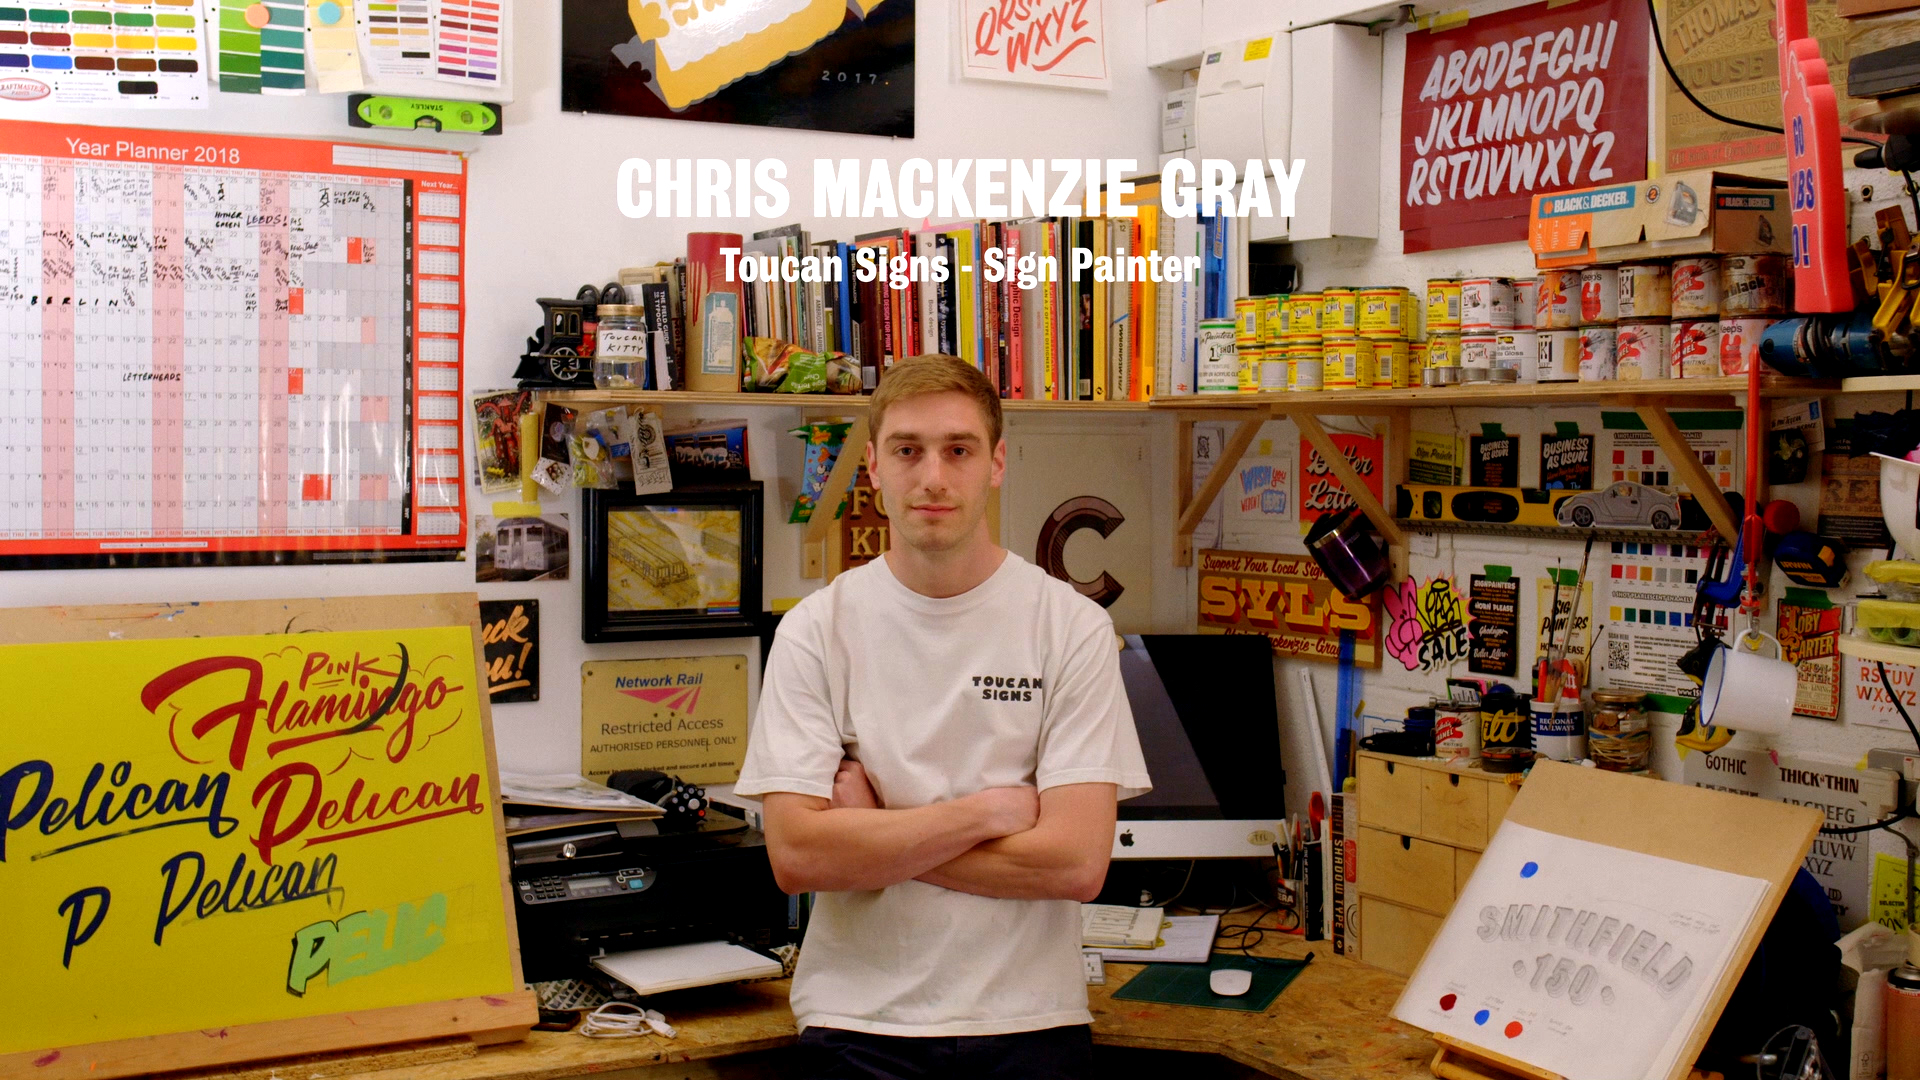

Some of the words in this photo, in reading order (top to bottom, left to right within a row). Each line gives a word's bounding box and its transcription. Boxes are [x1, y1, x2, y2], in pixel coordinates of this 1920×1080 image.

[1673, 0, 1762, 54] THOMAS
[1419, 19, 1617, 102] ABCDEFGHI
[410, 101, 444, 112] STANLEY
[1415, 77, 1604, 156] JKLMNOPQ
[66, 137, 112, 158] Year
[116, 140, 190, 163] Planner
[194, 145, 241, 165] 2018
[1406, 130, 1615, 207] RSTUVWXYZ
[421, 180, 437, 188] Next
[1012, 307, 1021, 337] Design
[1180, 299, 1188, 325] Identity
[927, 317, 935, 337] design
[603, 332, 644, 345] TOUCAN
[606, 344, 644, 353] KITTY
[122, 371, 181, 383] LETTERHEADS
[1543, 438, 1589, 458] BUSINESS
[1546, 456, 1560, 470] AS
[1560, 451, 1588, 467] USUAL
[1036, 495, 1126, 610] C
[1203, 555, 1241, 571] Support
[1244, 557, 1268, 573] Your
[1272, 559, 1299, 575] Local
[1780, 560, 1813, 570] IRWIN
[1492, 603, 1515, 613] PLEASE
[1419, 627, 1468, 671] SALE
[616, 674, 673, 689] Network
[677, 672, 704, 686] Rail
[972, 676, 1043, 689] TOUCAN
[982, 689, 1032, 702] SIGNS
[141, 655, 463, 771] Flamingo
[601, 719, 672, 735] Restricted
[677, 718, 724, 731] Access
[589, 741, 653, 753] AUTHORISED
[656, 738, 711, 750] PERSONNEL
[714, 736, 737, 746] ONLY
[1706, 754, 1747, 775] GOTHIC
[1780, 767, 1820, 788] THICK
[1825, 774, 1859, 794] THIN
[0, 760, 239, 862] Pelican
[249, 762, 485, 866] Pelican
[564, 843, 576, 859] hp
[1334, 838, 1344, 894] SHADOW
[153, 851, 345, 946] Pelican
[1334, 899, 1344, 928] TYPE
[59, 886, 111, 969] P
[1477, 903, 1693, 999] SMITHFIELD
